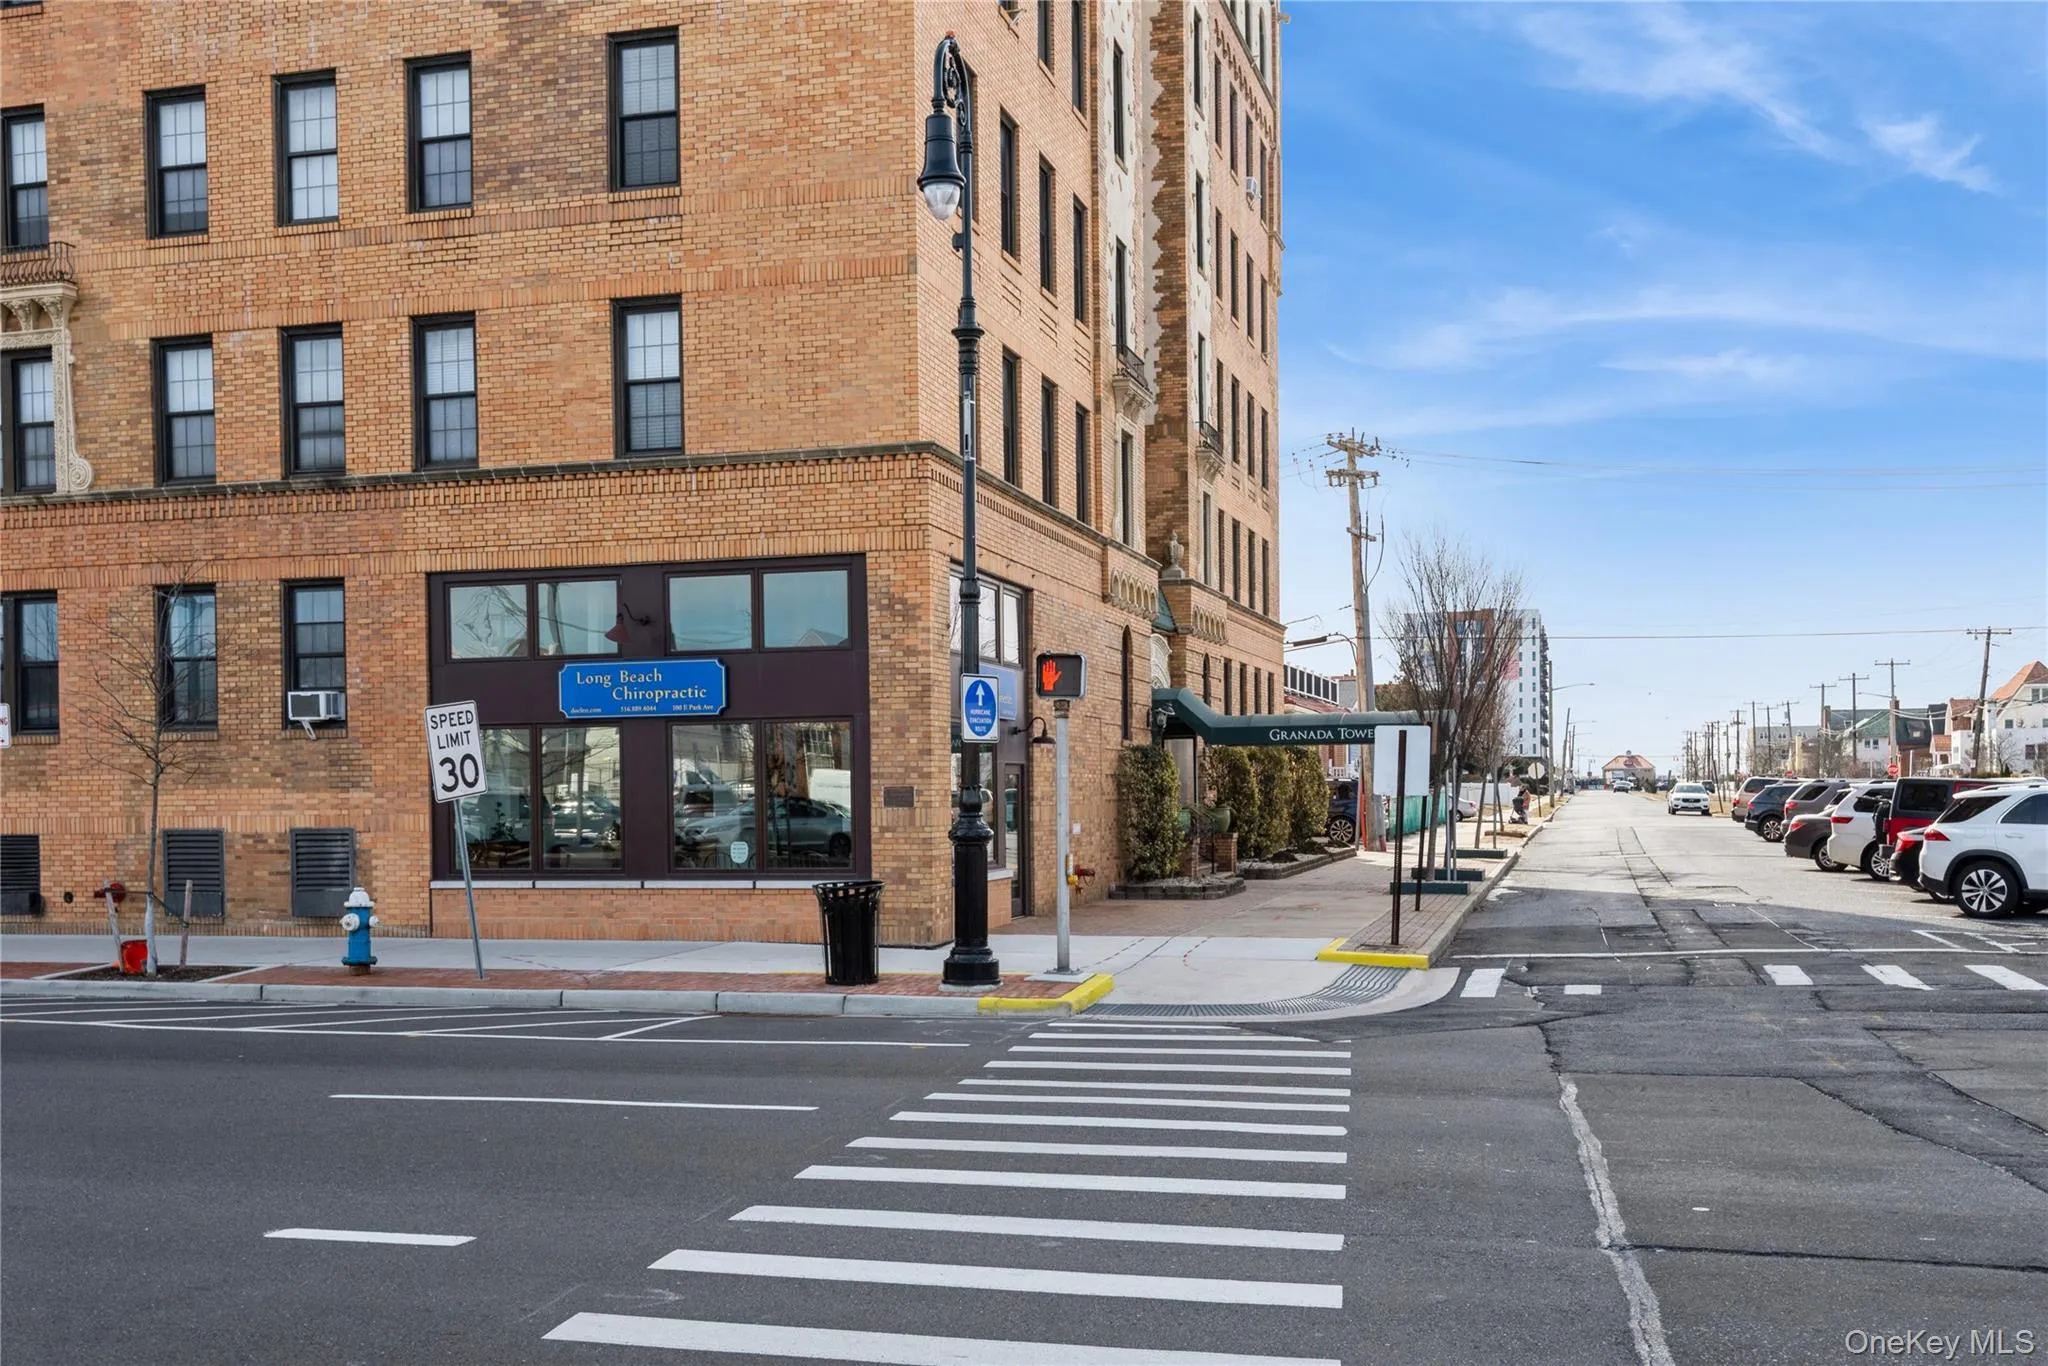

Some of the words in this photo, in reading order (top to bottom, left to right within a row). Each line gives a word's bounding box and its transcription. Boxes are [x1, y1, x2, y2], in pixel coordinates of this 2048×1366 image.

[576, 671, 612, 688] Long
[619, 668, 663, 683] Beach
[612, 685, 707, 702] Chiropractic
[430, 710, 474, 730] SPEED
[437, 730, 471, 750] LIMIT
[1337, 727, 1375, 739] TOWE
[439, 753, 479, 792] 30
